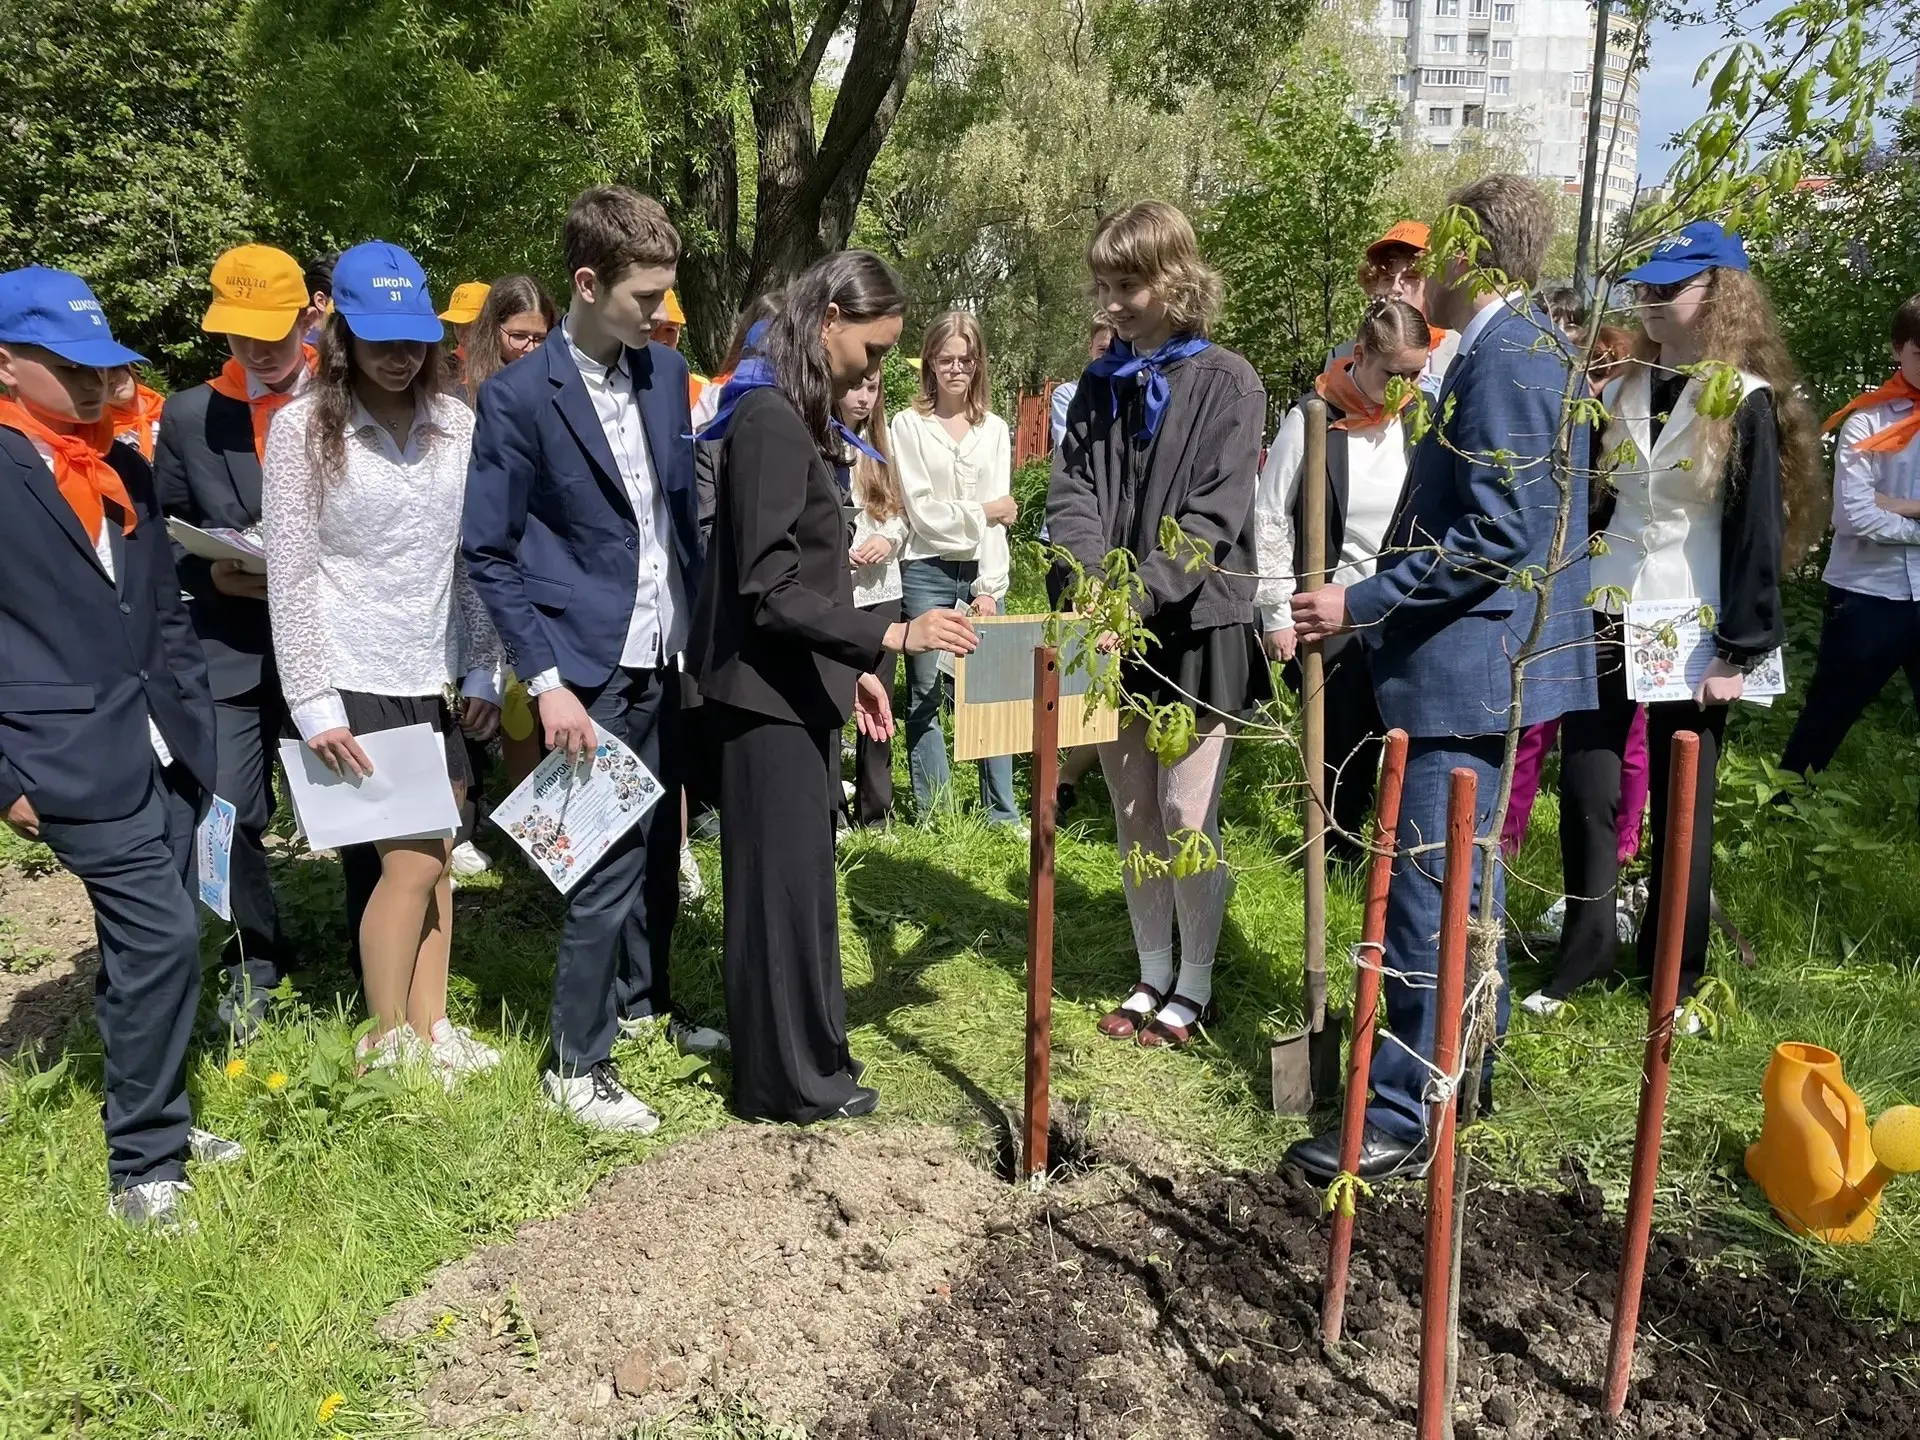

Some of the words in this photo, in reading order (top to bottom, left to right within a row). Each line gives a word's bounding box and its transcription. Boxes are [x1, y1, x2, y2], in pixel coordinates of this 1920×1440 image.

[372, 276, 413, 288] ШКОЛА
[235, 286, 252, 299] 31
[390, 290, 402, 302] 31
[90, 314, 102, 326] 31
[536, 759, 571, 799] ДИПЛОМ
